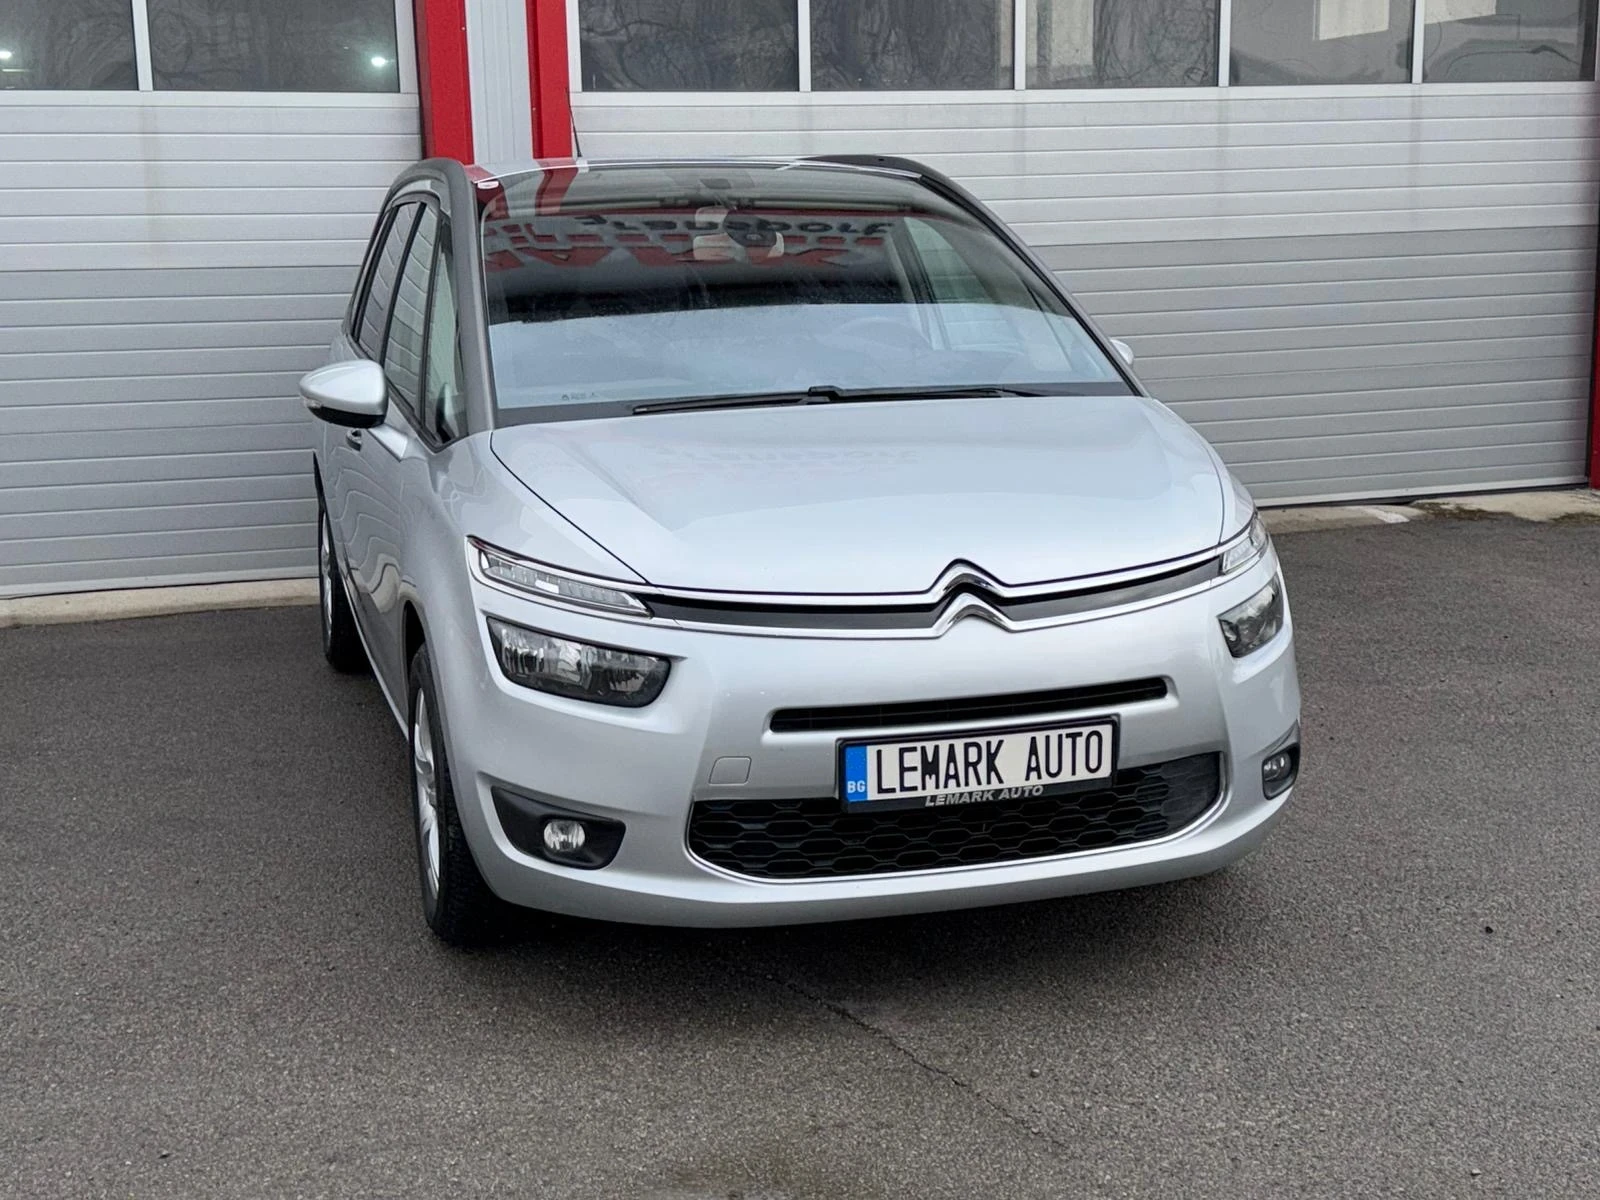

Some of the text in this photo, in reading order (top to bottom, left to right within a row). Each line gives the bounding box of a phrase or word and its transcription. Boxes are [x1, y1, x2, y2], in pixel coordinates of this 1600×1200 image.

[876, 730, 1104, 795] LEMARK AUTO
[847, 781, 866, 794] BG
[925, 785, 1044, 808] LEMARK AUTO
